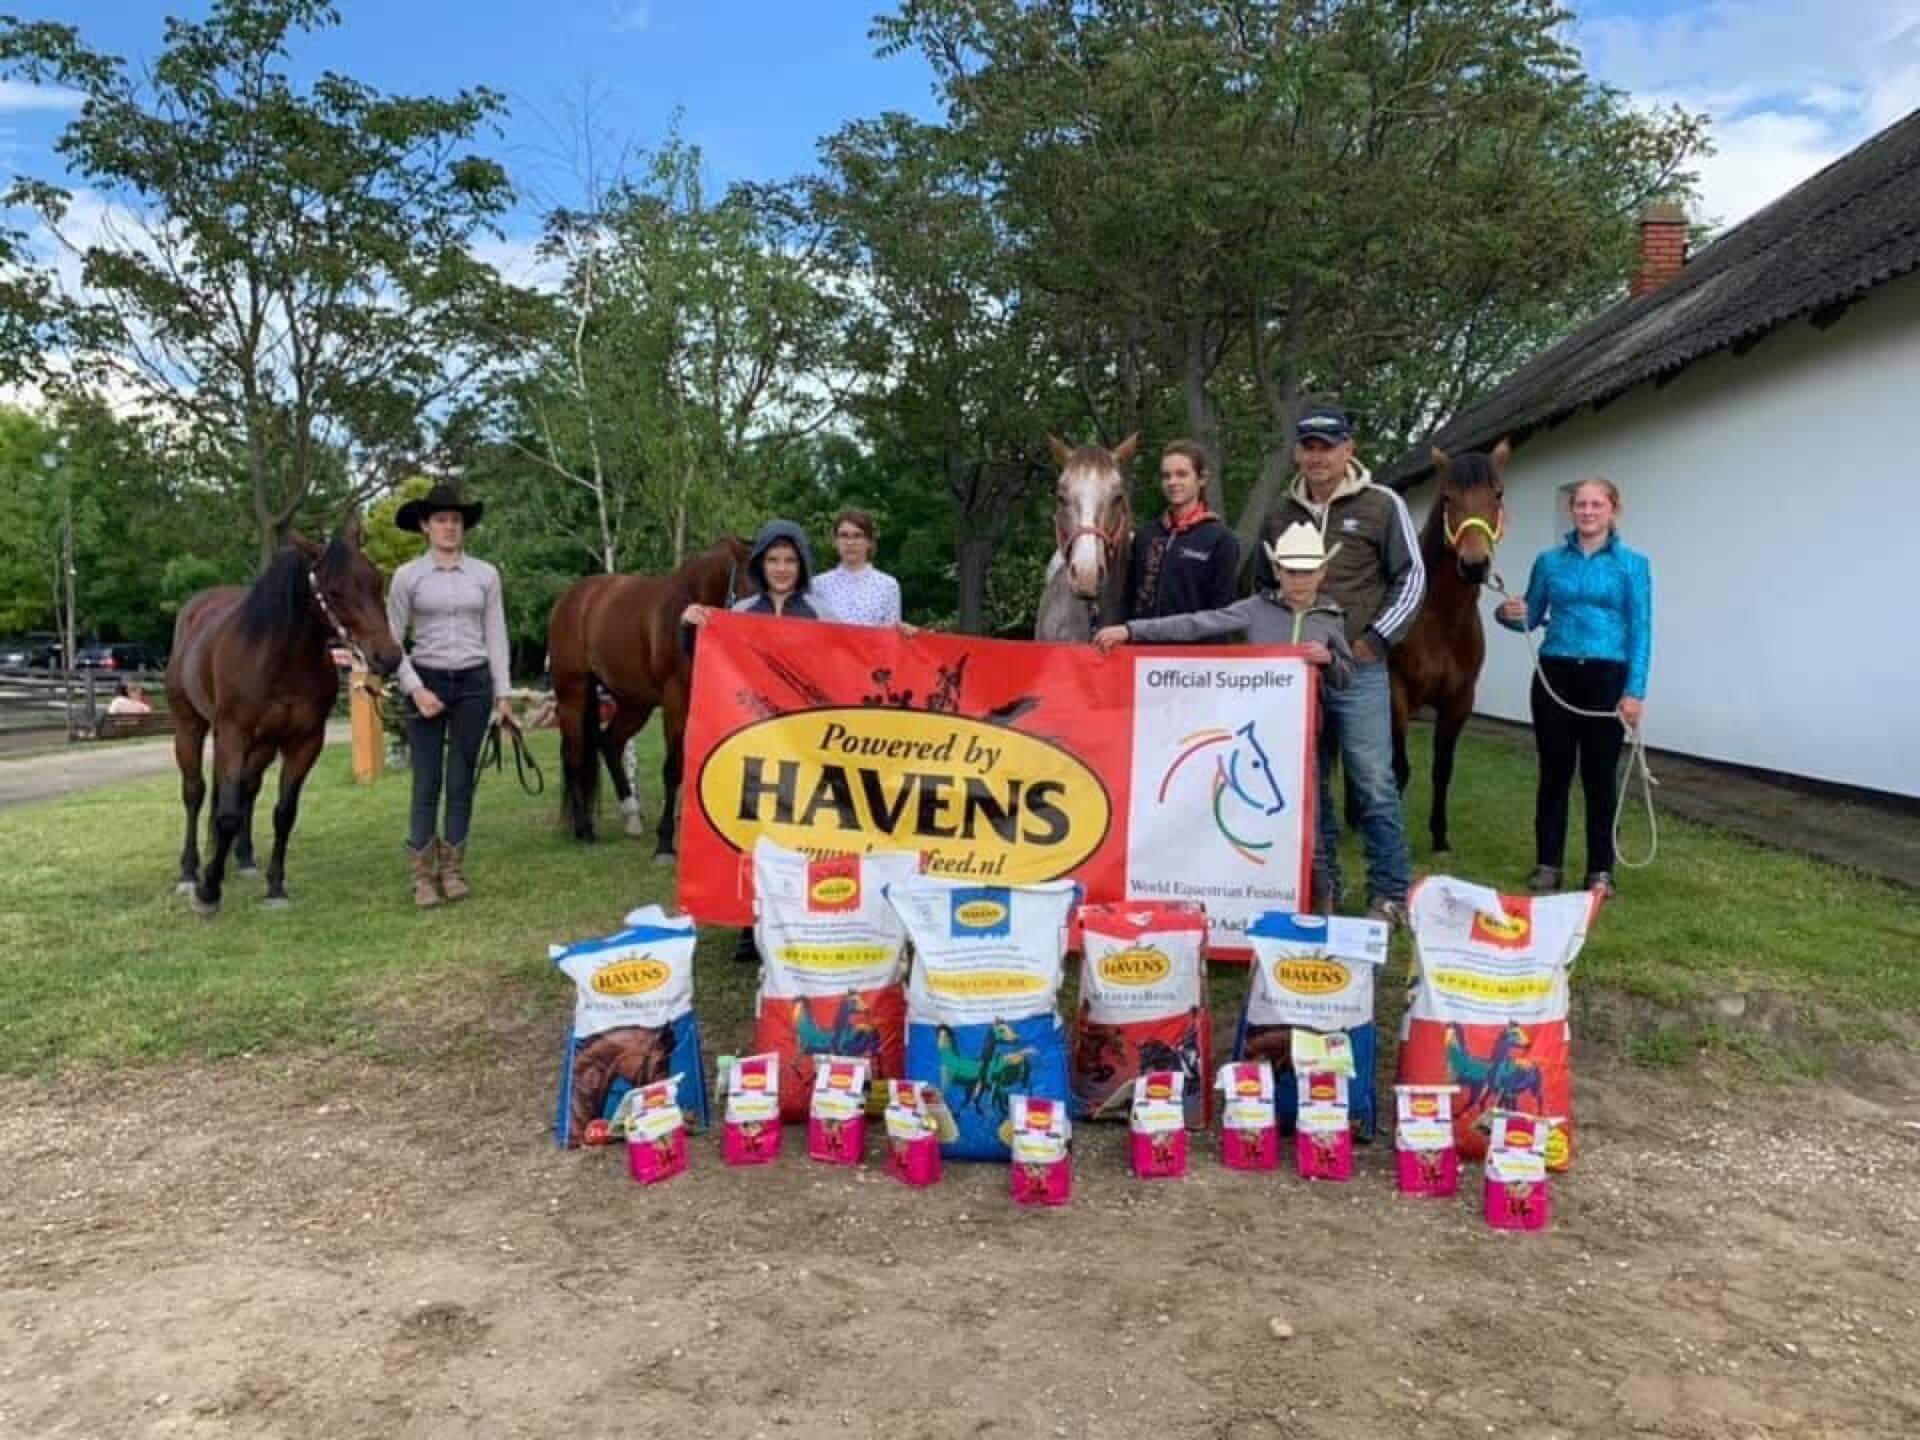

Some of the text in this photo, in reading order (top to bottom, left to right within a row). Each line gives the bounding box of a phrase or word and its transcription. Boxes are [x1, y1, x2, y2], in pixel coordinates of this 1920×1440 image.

[1147, 669, 1294, 693] Official Supplier
[819, 723, 1002, 774] Powered by
[737, 756, 1072, 846] HAVENS
[1131, 879, 1297, 900] World Equestrian Festival
[599, 966, 663, 988] HAVENS
[1103, 959, 1164, 977] HAVENS
[1280, 966, 1342, 985] HAVENS
